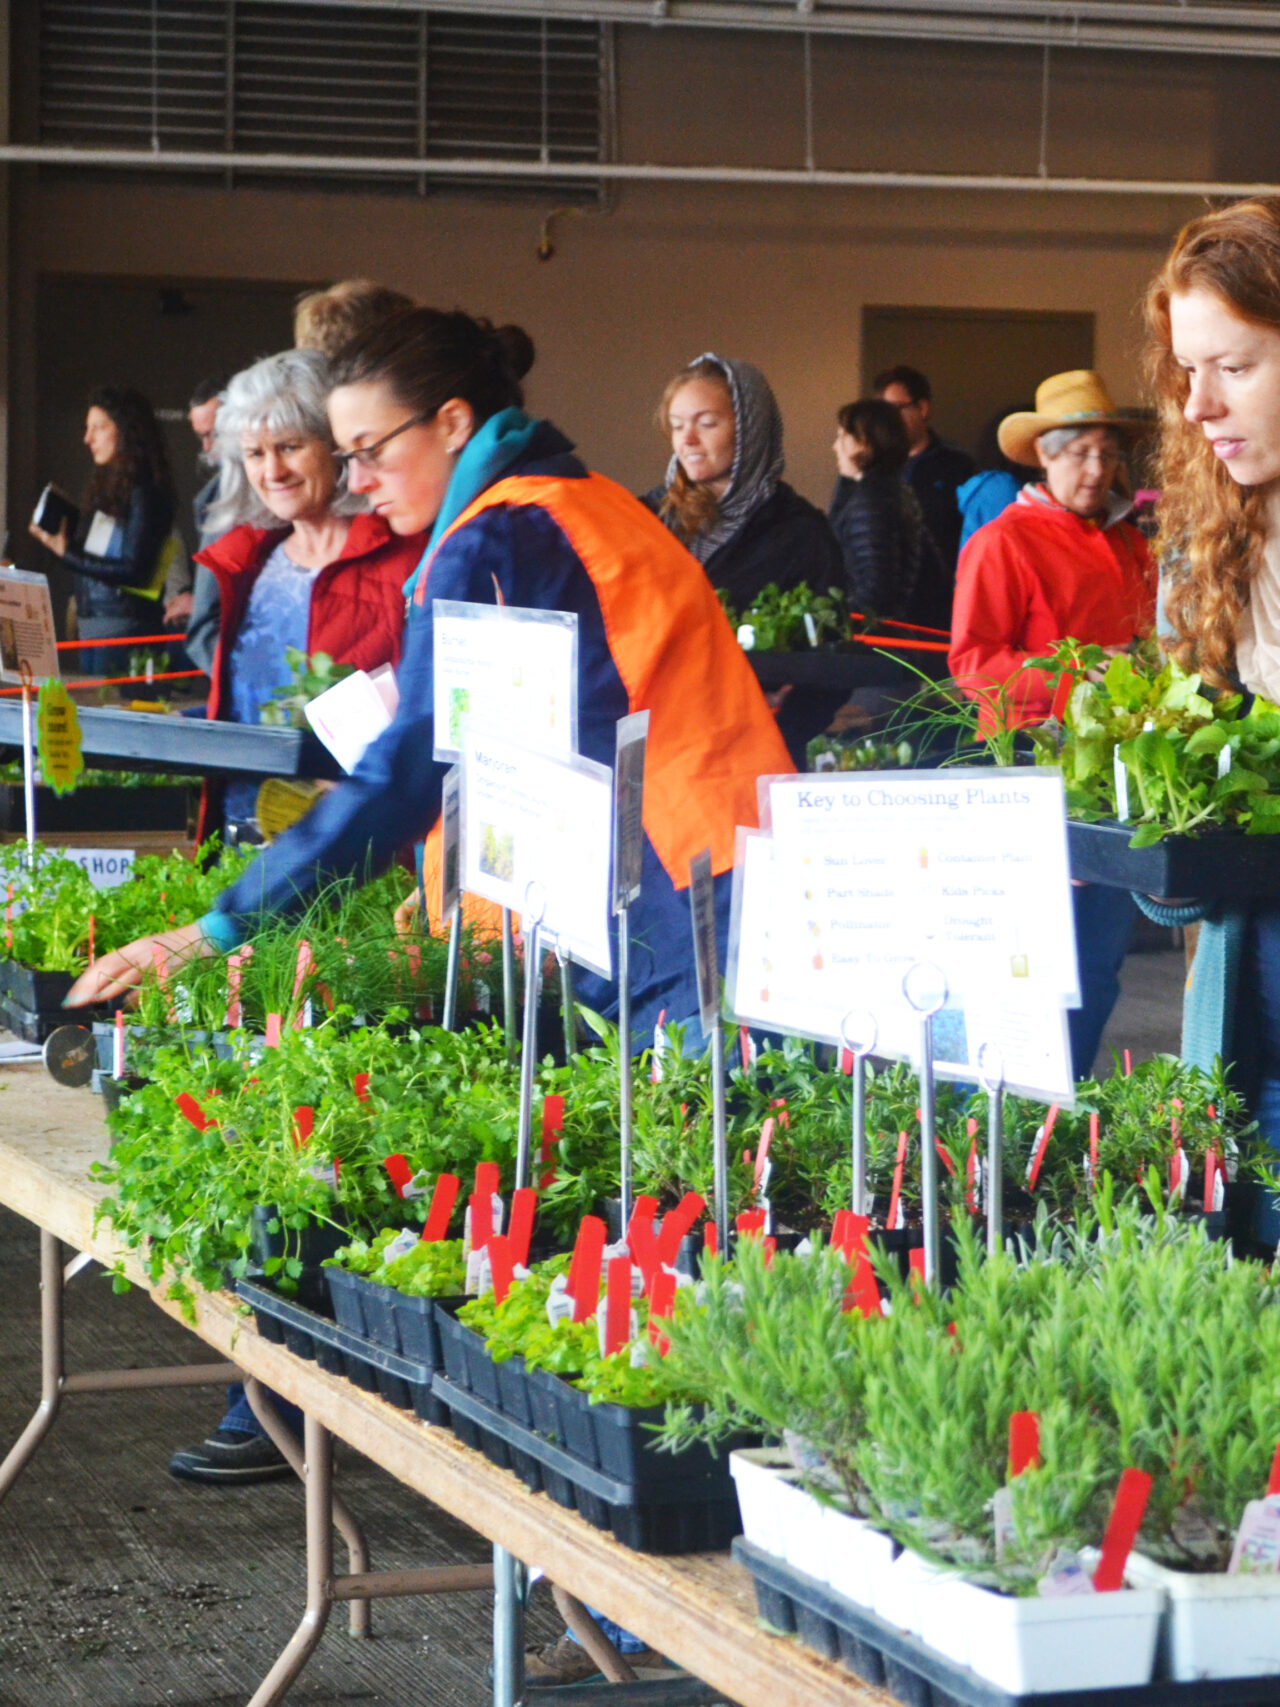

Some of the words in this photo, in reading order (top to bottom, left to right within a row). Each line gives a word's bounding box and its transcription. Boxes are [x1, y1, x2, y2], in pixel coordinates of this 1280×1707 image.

[797, 791, 836, 811] Key
[842, 792, 861, 807] to
[867, 789, 960, 810] Choosing
[966, 788, 1031, 805] Plants
[824, 856, 848, 866] Sun
[852, 856, 887, 866] Lover
[827, 888, 853, 898] Part
[942, 887, 968, 896] Kids
[832, 953, 860, 964] Easy
